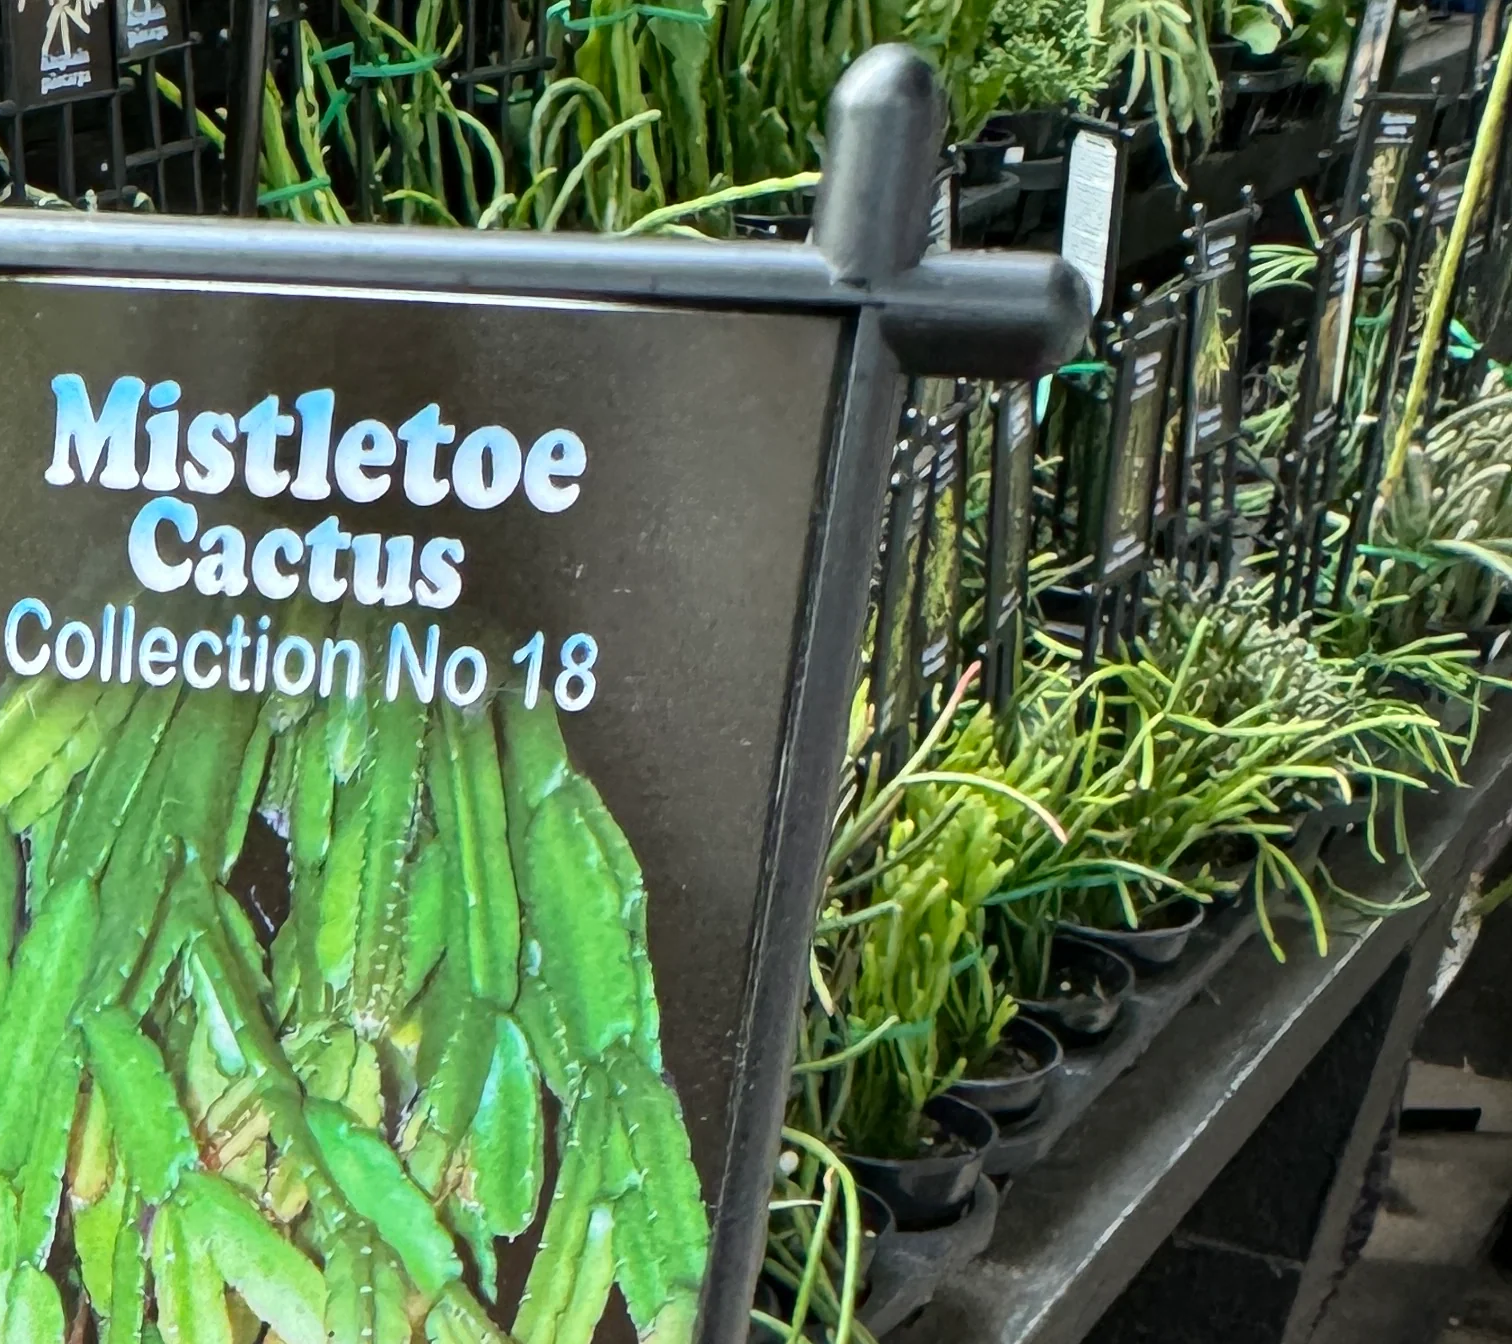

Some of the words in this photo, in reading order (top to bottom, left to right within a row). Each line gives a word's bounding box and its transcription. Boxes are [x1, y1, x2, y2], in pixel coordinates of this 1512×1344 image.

[44, 372, 587, 513] Mistletoe
[128, 496, 465, 609] Cactus
[4, 597, 362, 700] Collection
[386, 621, 488, 708] No
[513, 630, 599, 712] 18
